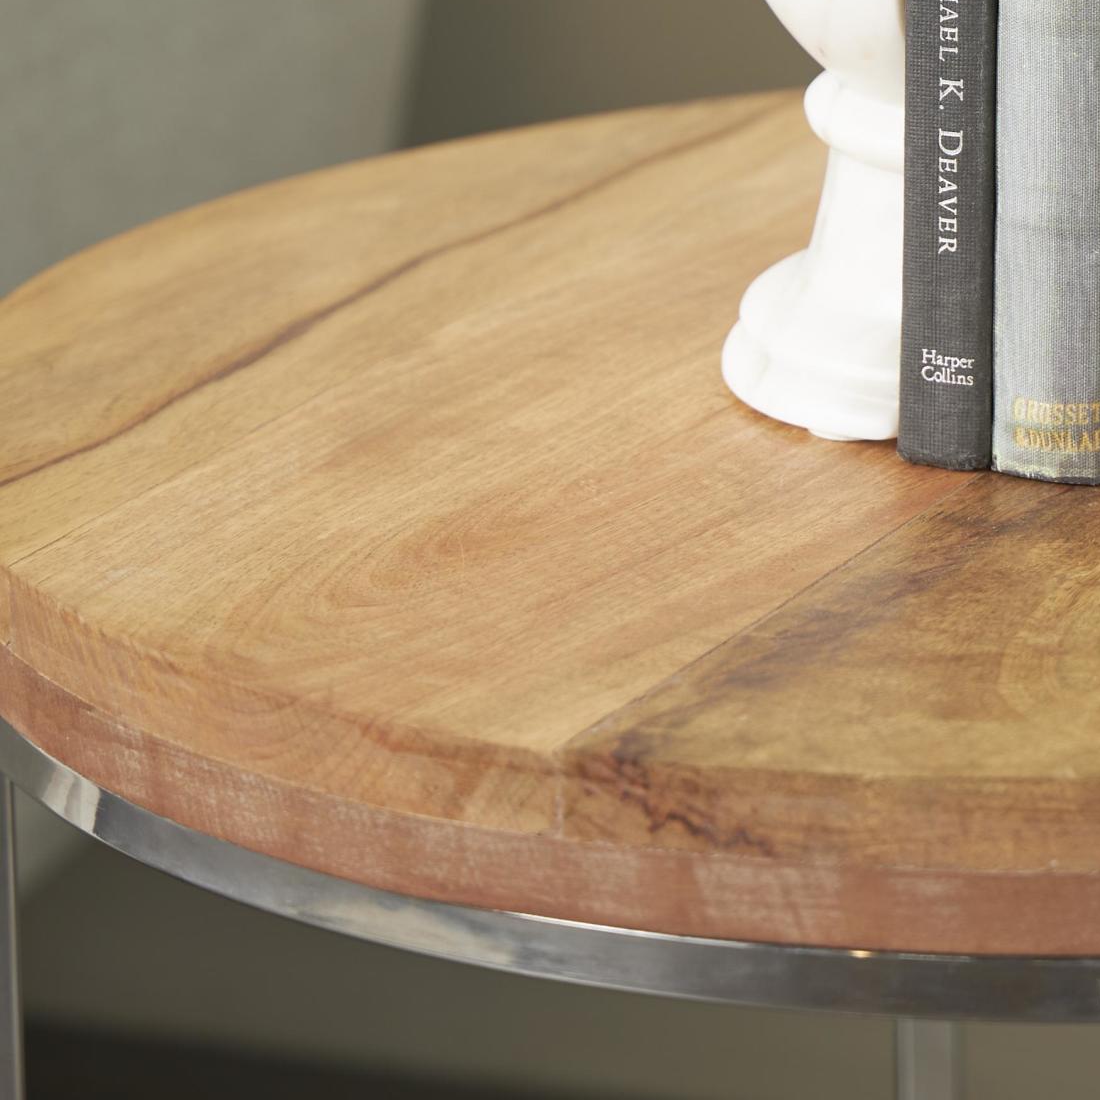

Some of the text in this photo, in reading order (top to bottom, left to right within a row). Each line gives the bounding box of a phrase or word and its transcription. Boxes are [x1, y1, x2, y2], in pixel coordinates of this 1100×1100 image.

[938, 76, 964, 111] K.
[937, 127, 963, 254] DEAVER
[921, 348, 975, 372] Harper
[921, 366, 974, 386] Collins
